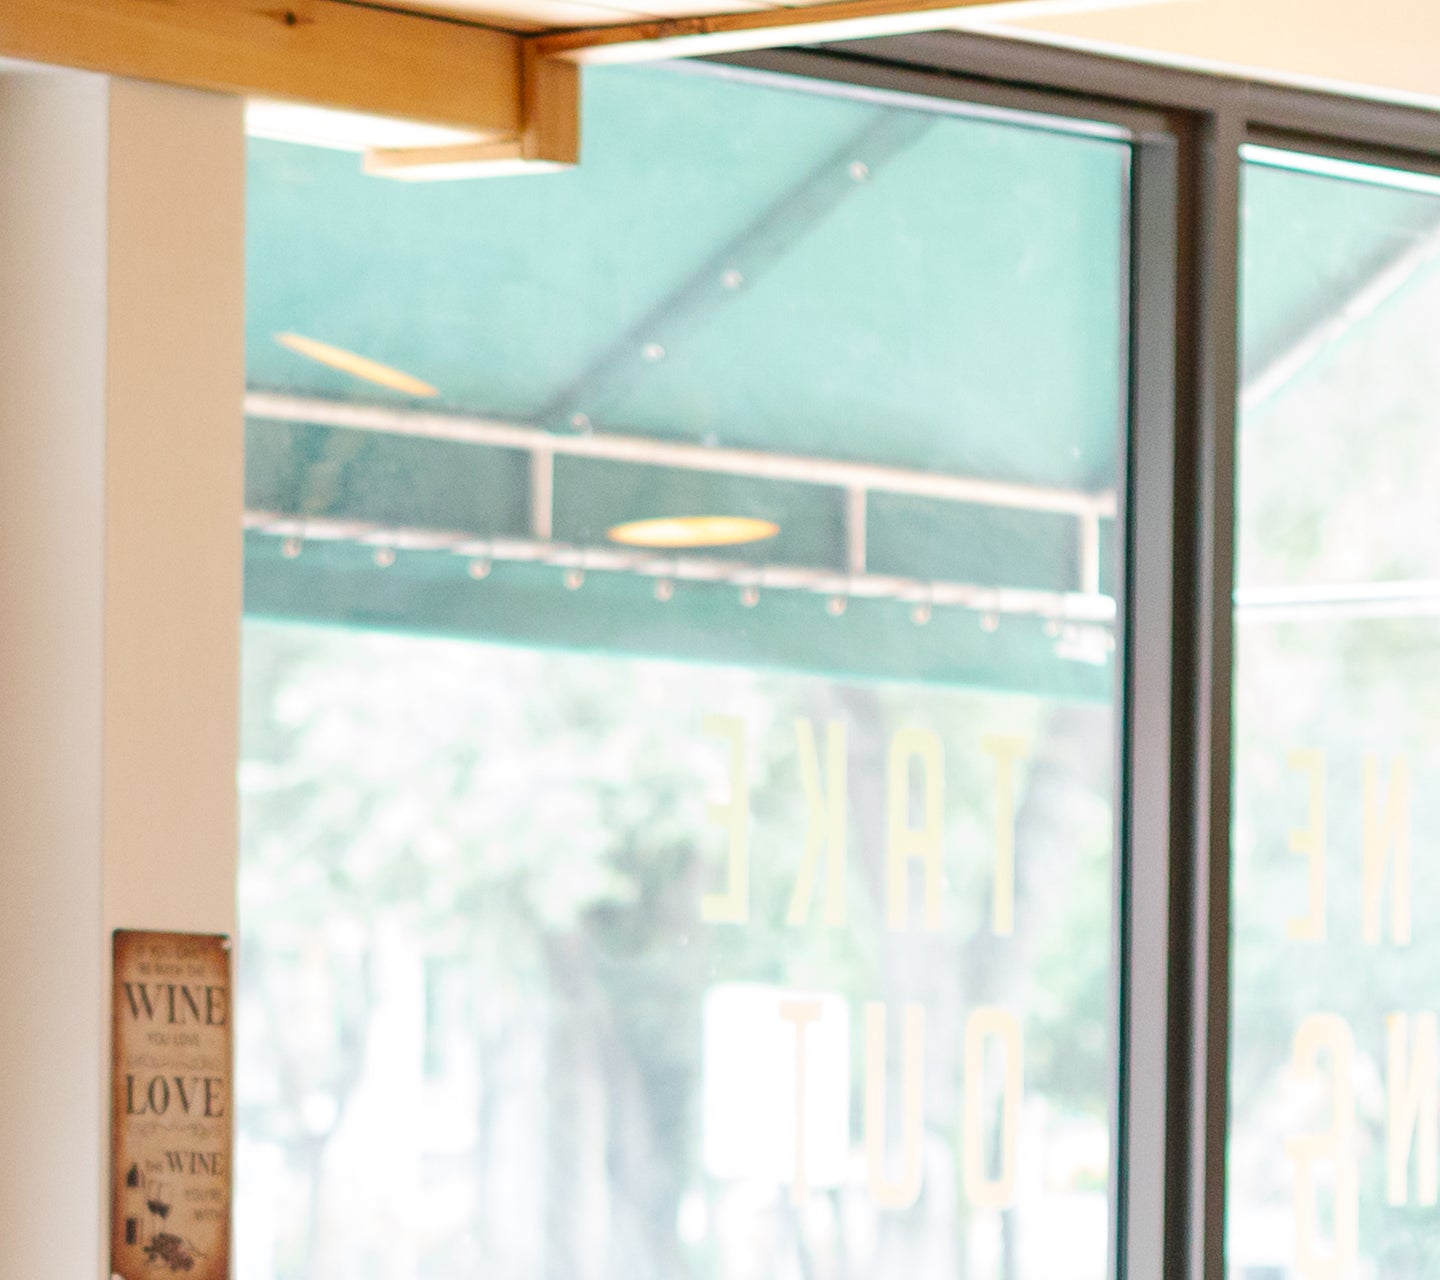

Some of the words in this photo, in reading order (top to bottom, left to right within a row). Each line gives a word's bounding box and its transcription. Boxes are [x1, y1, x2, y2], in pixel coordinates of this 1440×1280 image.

[123, 981, 226, 1027] WINE
[125, 1074, 225, 1119] LOVE
[164, 1149, 224, 1176] WINE
